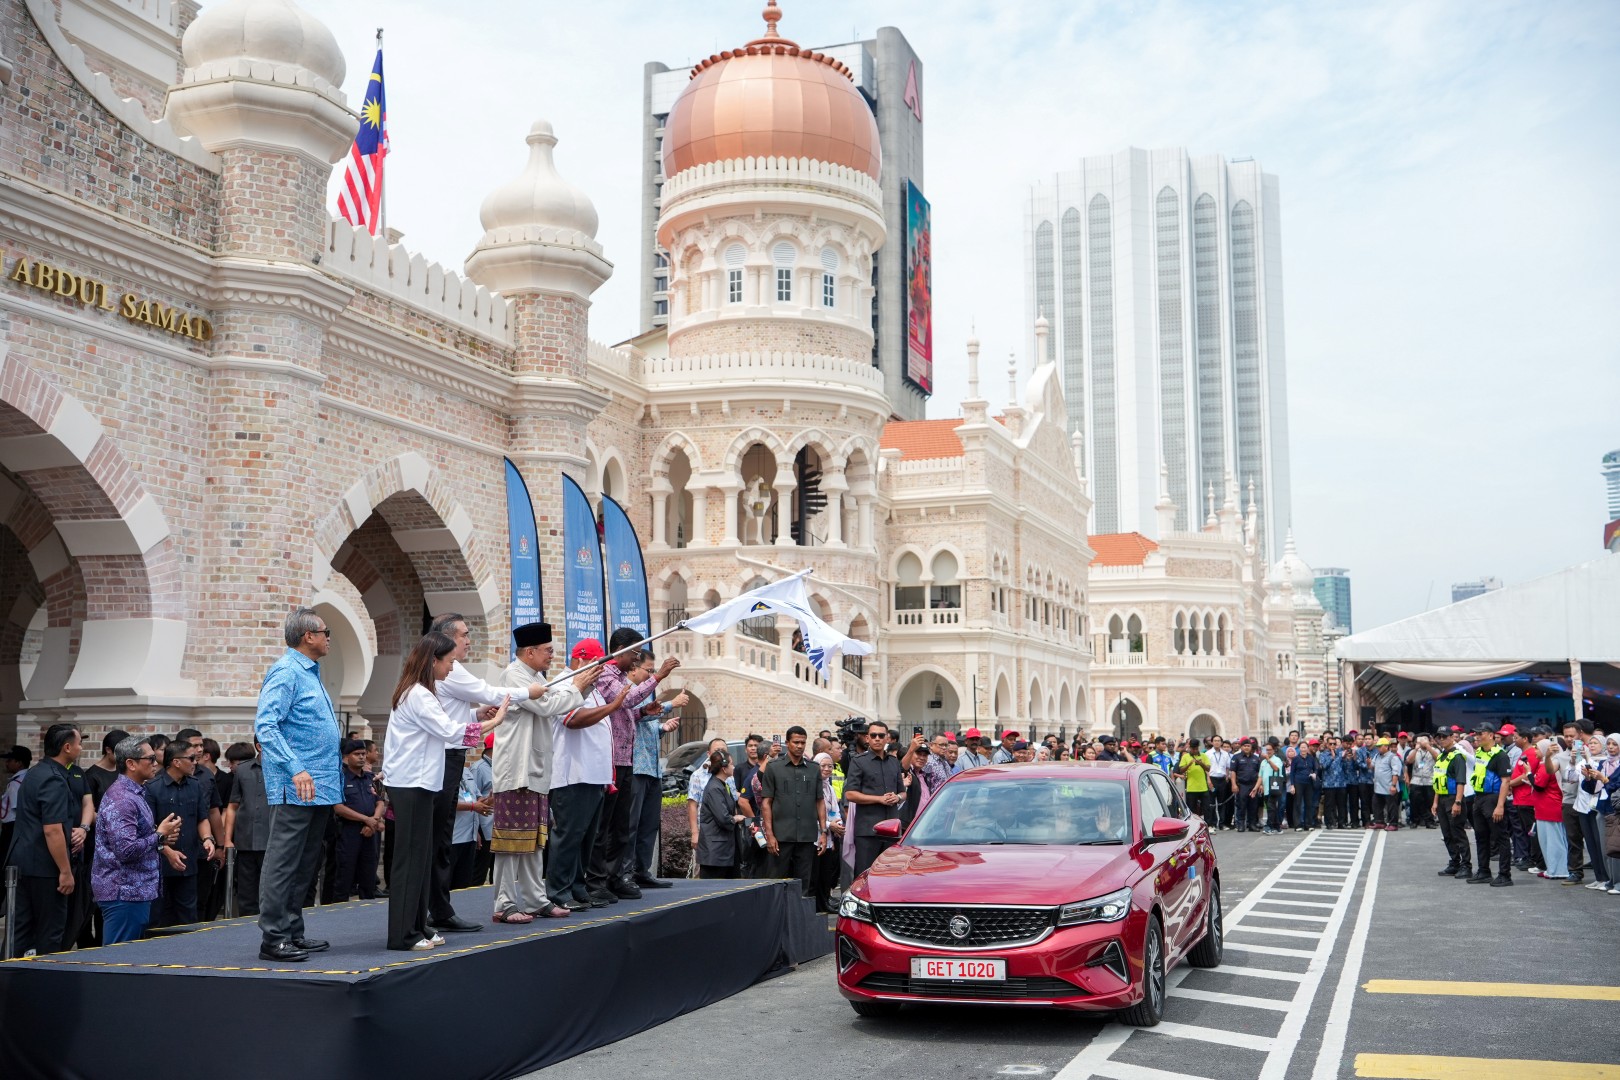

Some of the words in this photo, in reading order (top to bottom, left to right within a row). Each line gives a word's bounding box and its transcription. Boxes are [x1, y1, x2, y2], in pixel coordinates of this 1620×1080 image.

[11, 256, 115, 313] ABDUL
[119, 293, 214, 342] SAMAD
[927, 961, 954, 976] GET
[958, 962, 995, 978] 1020
